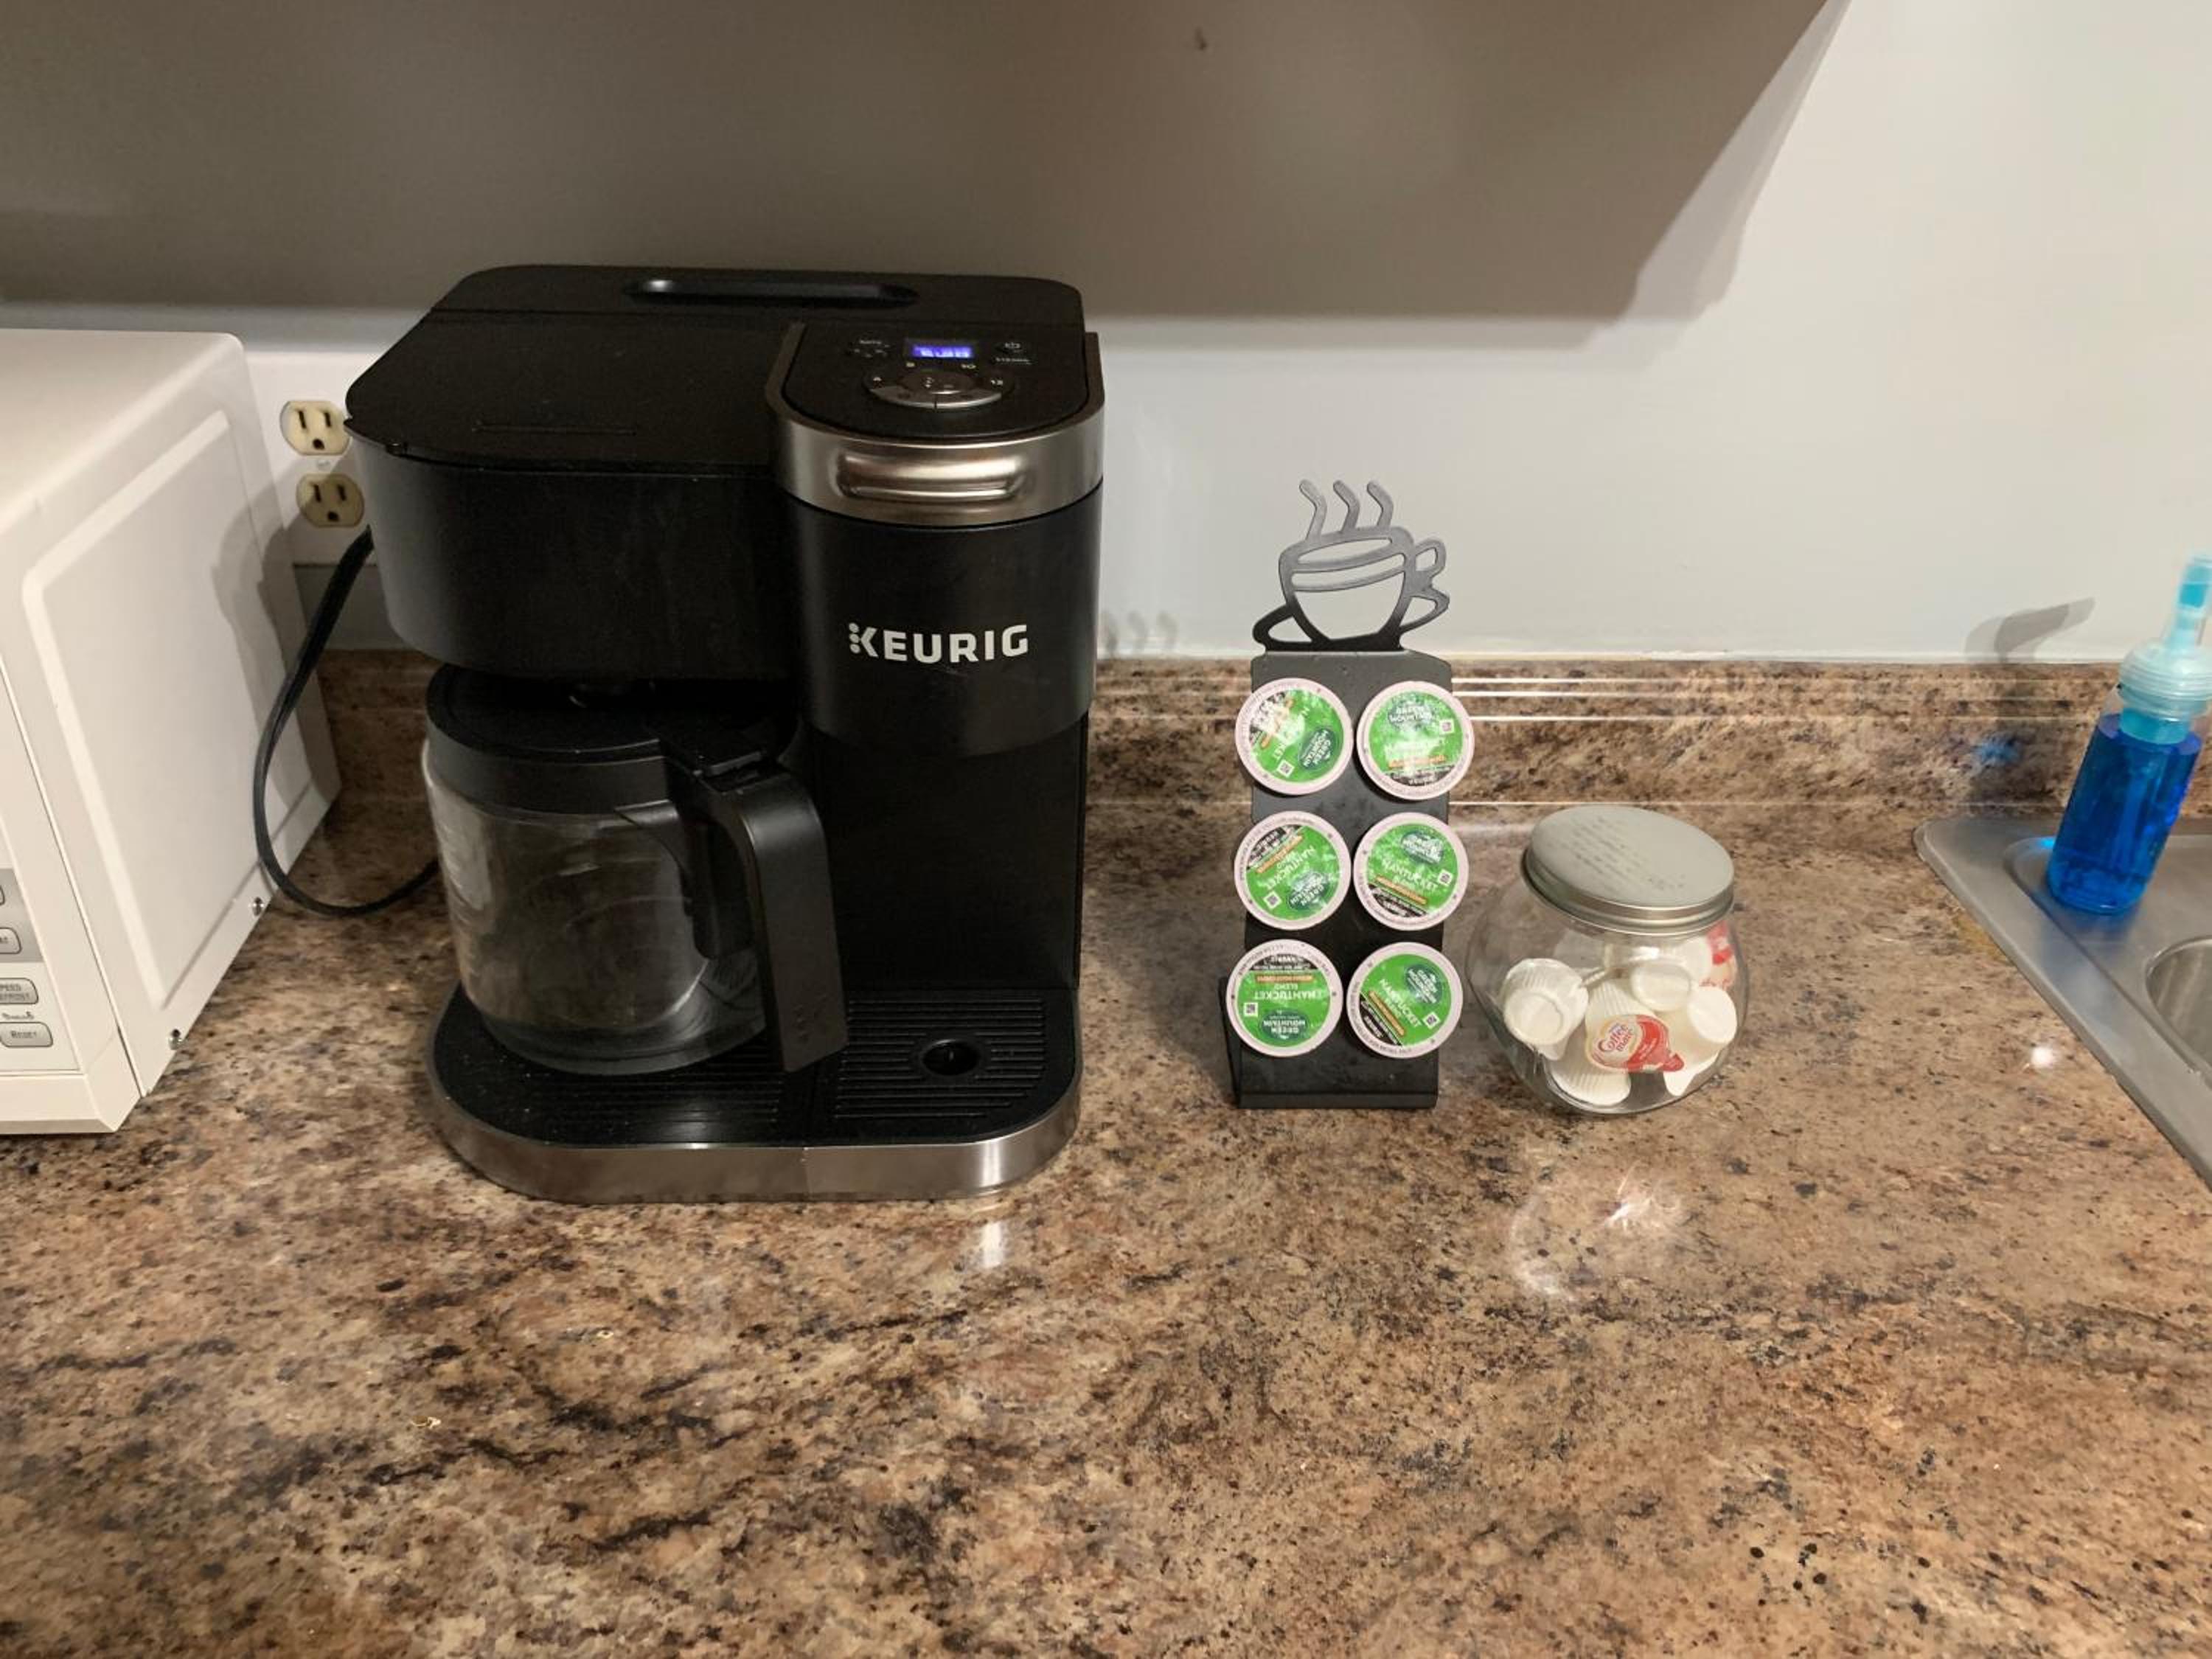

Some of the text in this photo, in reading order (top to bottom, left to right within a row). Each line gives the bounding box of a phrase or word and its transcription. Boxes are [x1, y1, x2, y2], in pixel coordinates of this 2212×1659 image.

[849, 623, 1029, 664] KEURIG
[1253, 990, 1315, 1000] NANTUCKET
[1378, 978, 1422, 1028] NANTUCKET
[1598, 1023, 1630, 1052] Coffee
